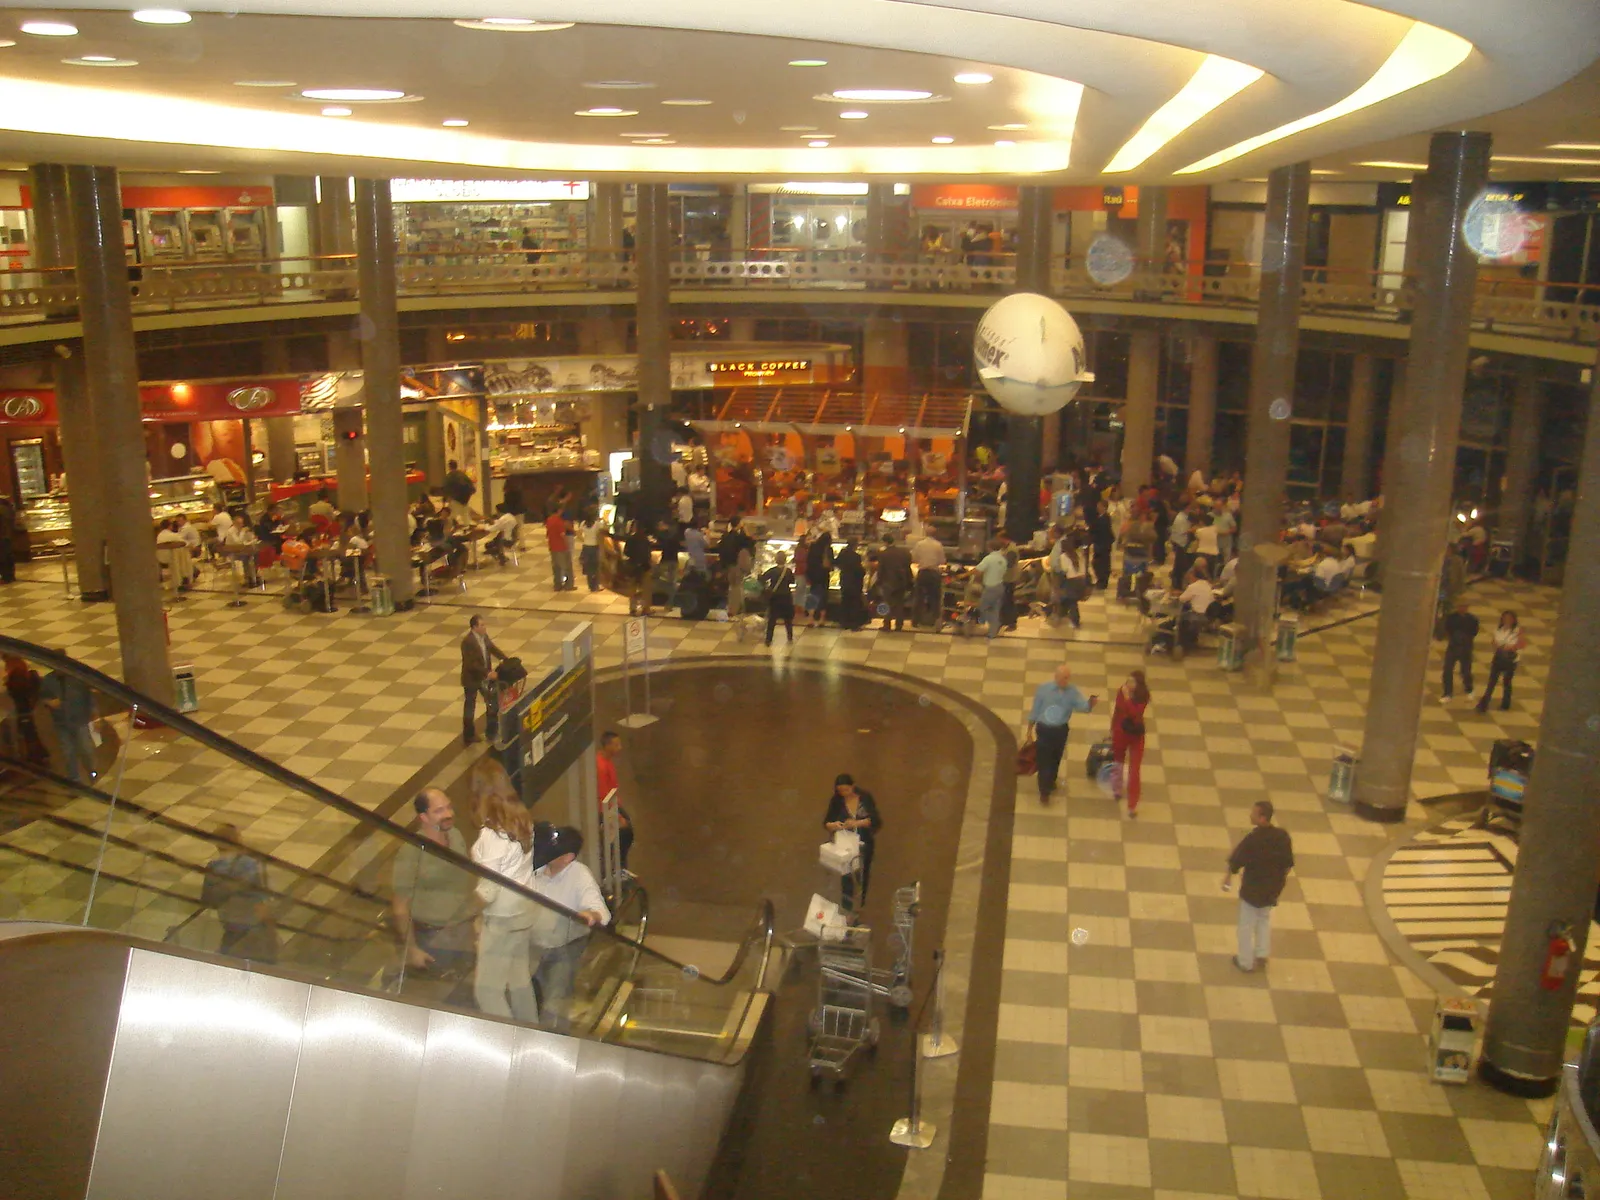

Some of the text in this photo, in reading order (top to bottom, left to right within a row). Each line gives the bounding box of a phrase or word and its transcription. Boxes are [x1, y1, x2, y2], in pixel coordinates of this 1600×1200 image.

[935, 196, 963, 206] Caixa
[710, 361, 807, 371] BLACK COFFEE
